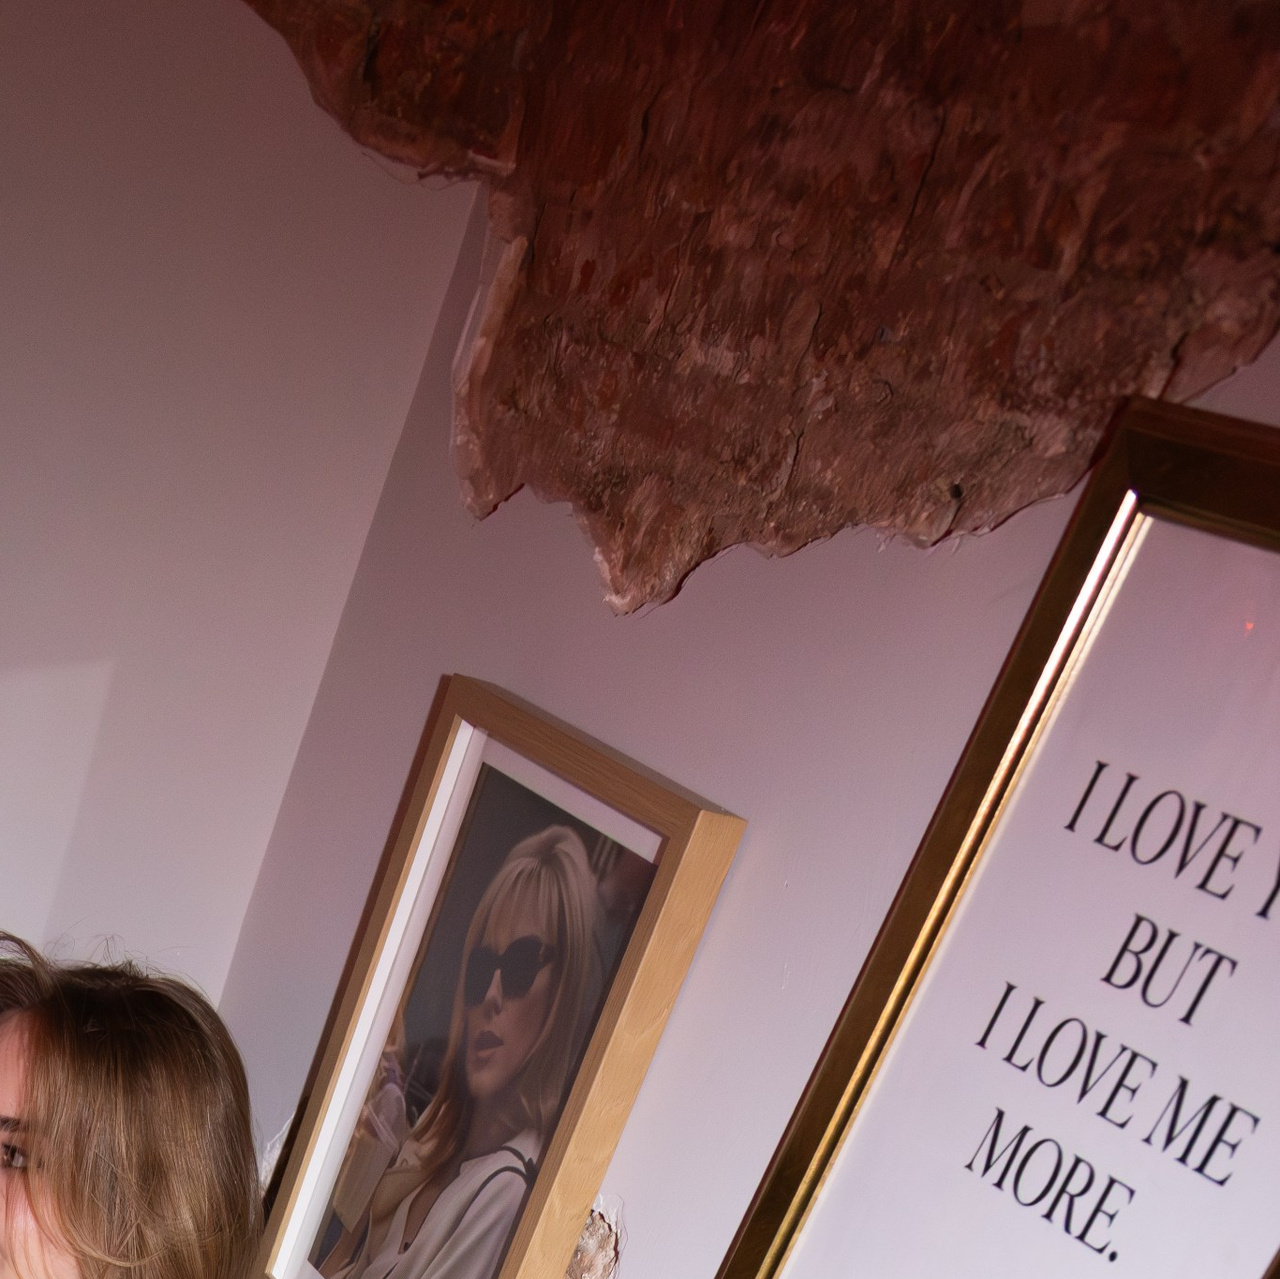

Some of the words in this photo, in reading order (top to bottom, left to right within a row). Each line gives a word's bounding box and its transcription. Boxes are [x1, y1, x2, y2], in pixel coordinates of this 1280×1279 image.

[1064, 760, 1109, 833] I
[1093, 772, 1263, 900] LOVE
[1100, 913, 1238, 1026] BUT
[975, 980, 1017, 1049] I
[1002, 997, 1158, 1129] LOVE
[1141, 1075, 1260, 1187] ME
[964, 1107, 1136, 1263] MORE.
